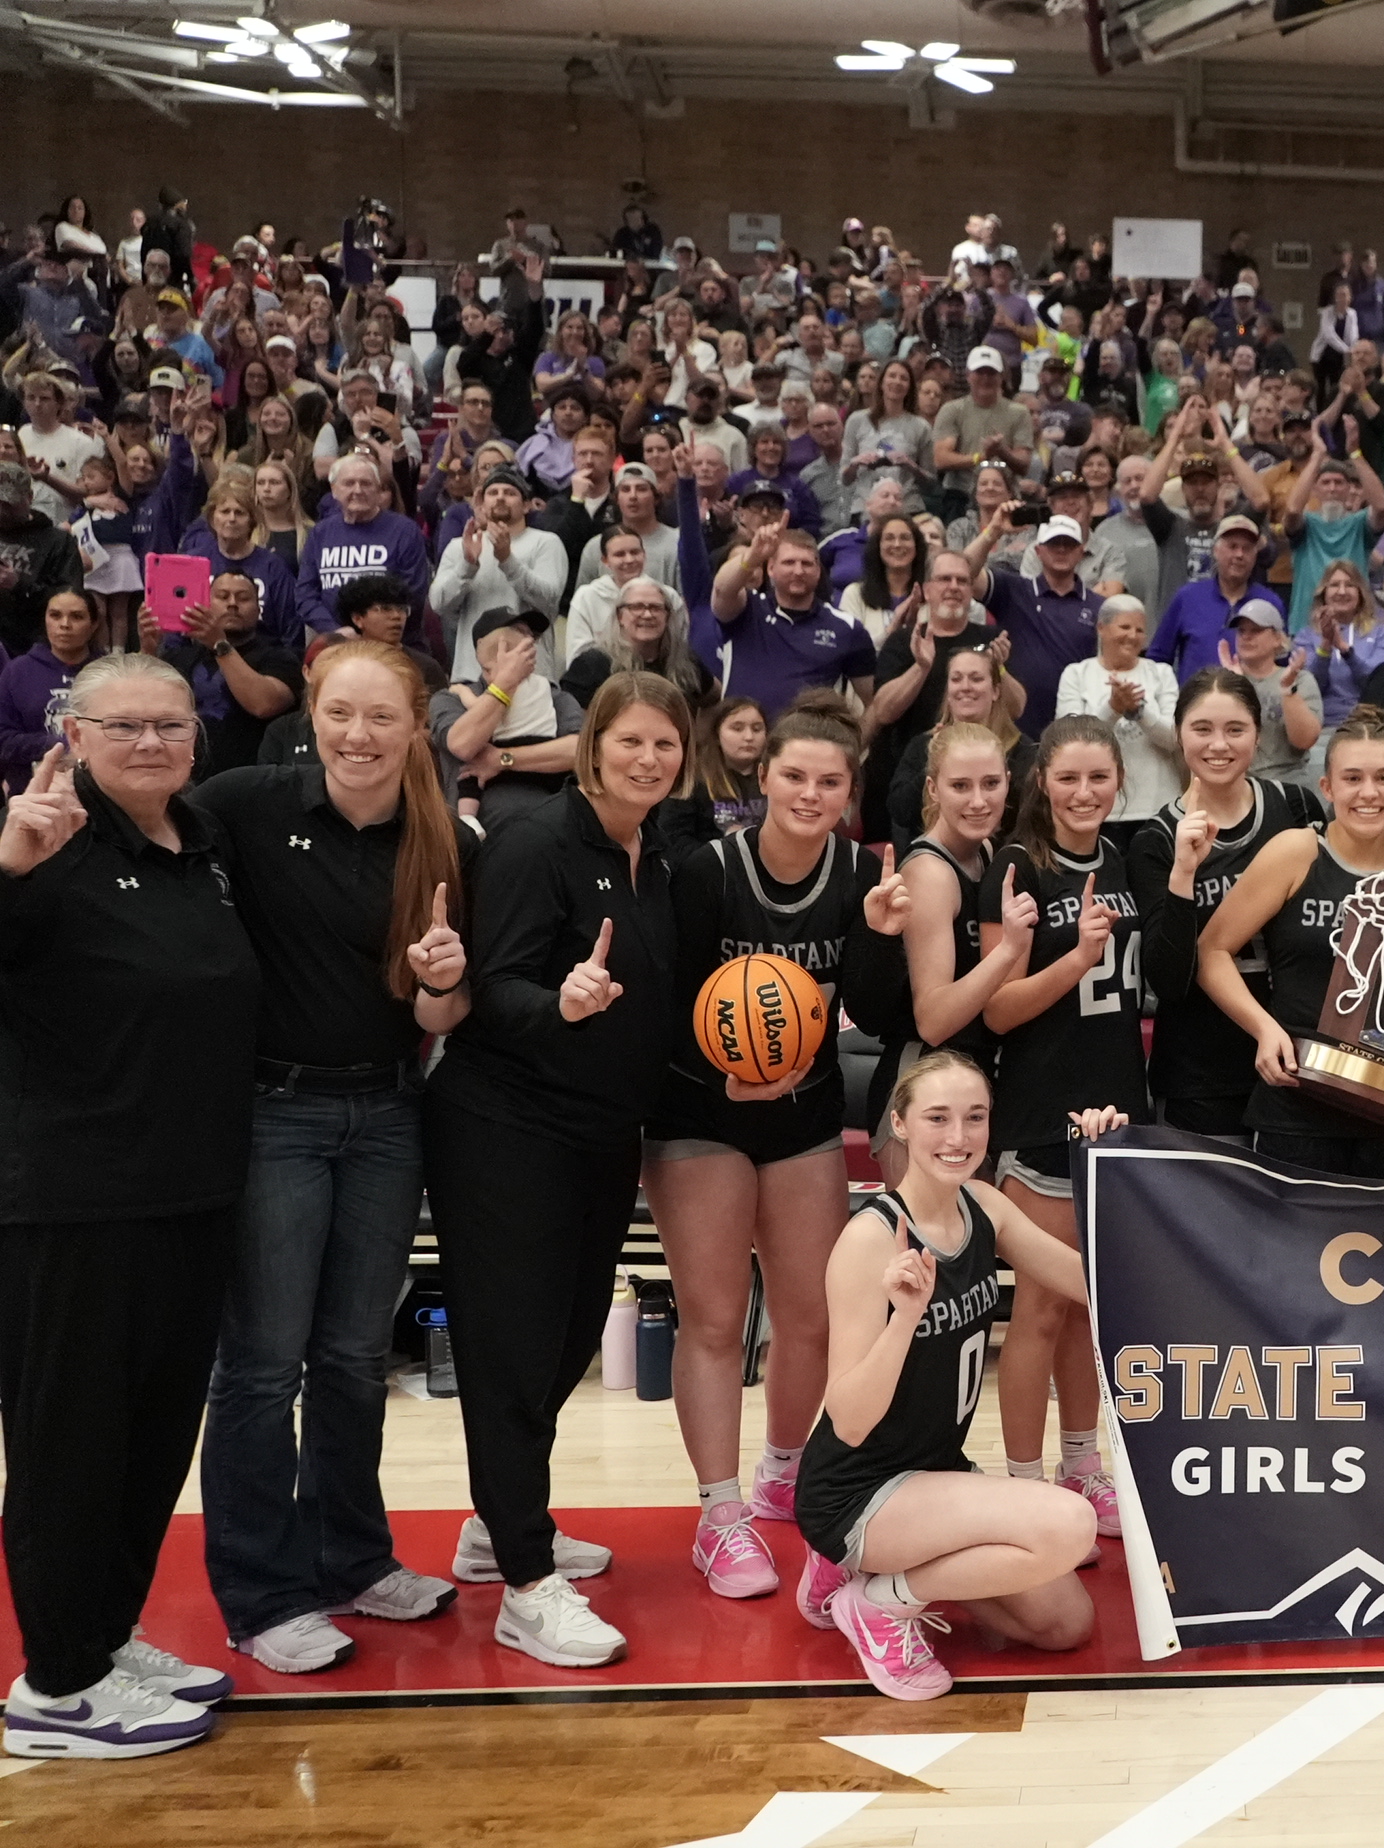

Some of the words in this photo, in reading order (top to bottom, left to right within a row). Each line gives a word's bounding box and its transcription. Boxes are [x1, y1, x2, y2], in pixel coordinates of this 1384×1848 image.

[320, 545, 388, 569] MIND
[1079, 931, 1141, 1017] 24
[717, 998, 745, 1063] NCAA
[755, 980, 788, 1068] Wilson
[1339, 1042, 1375, 1060] STATE
[956, 1329, 986, 1426] 0
[1113, 1343, 1365, 1425] STATE
[1170, 1445, 1365, 1497] GIRLS
